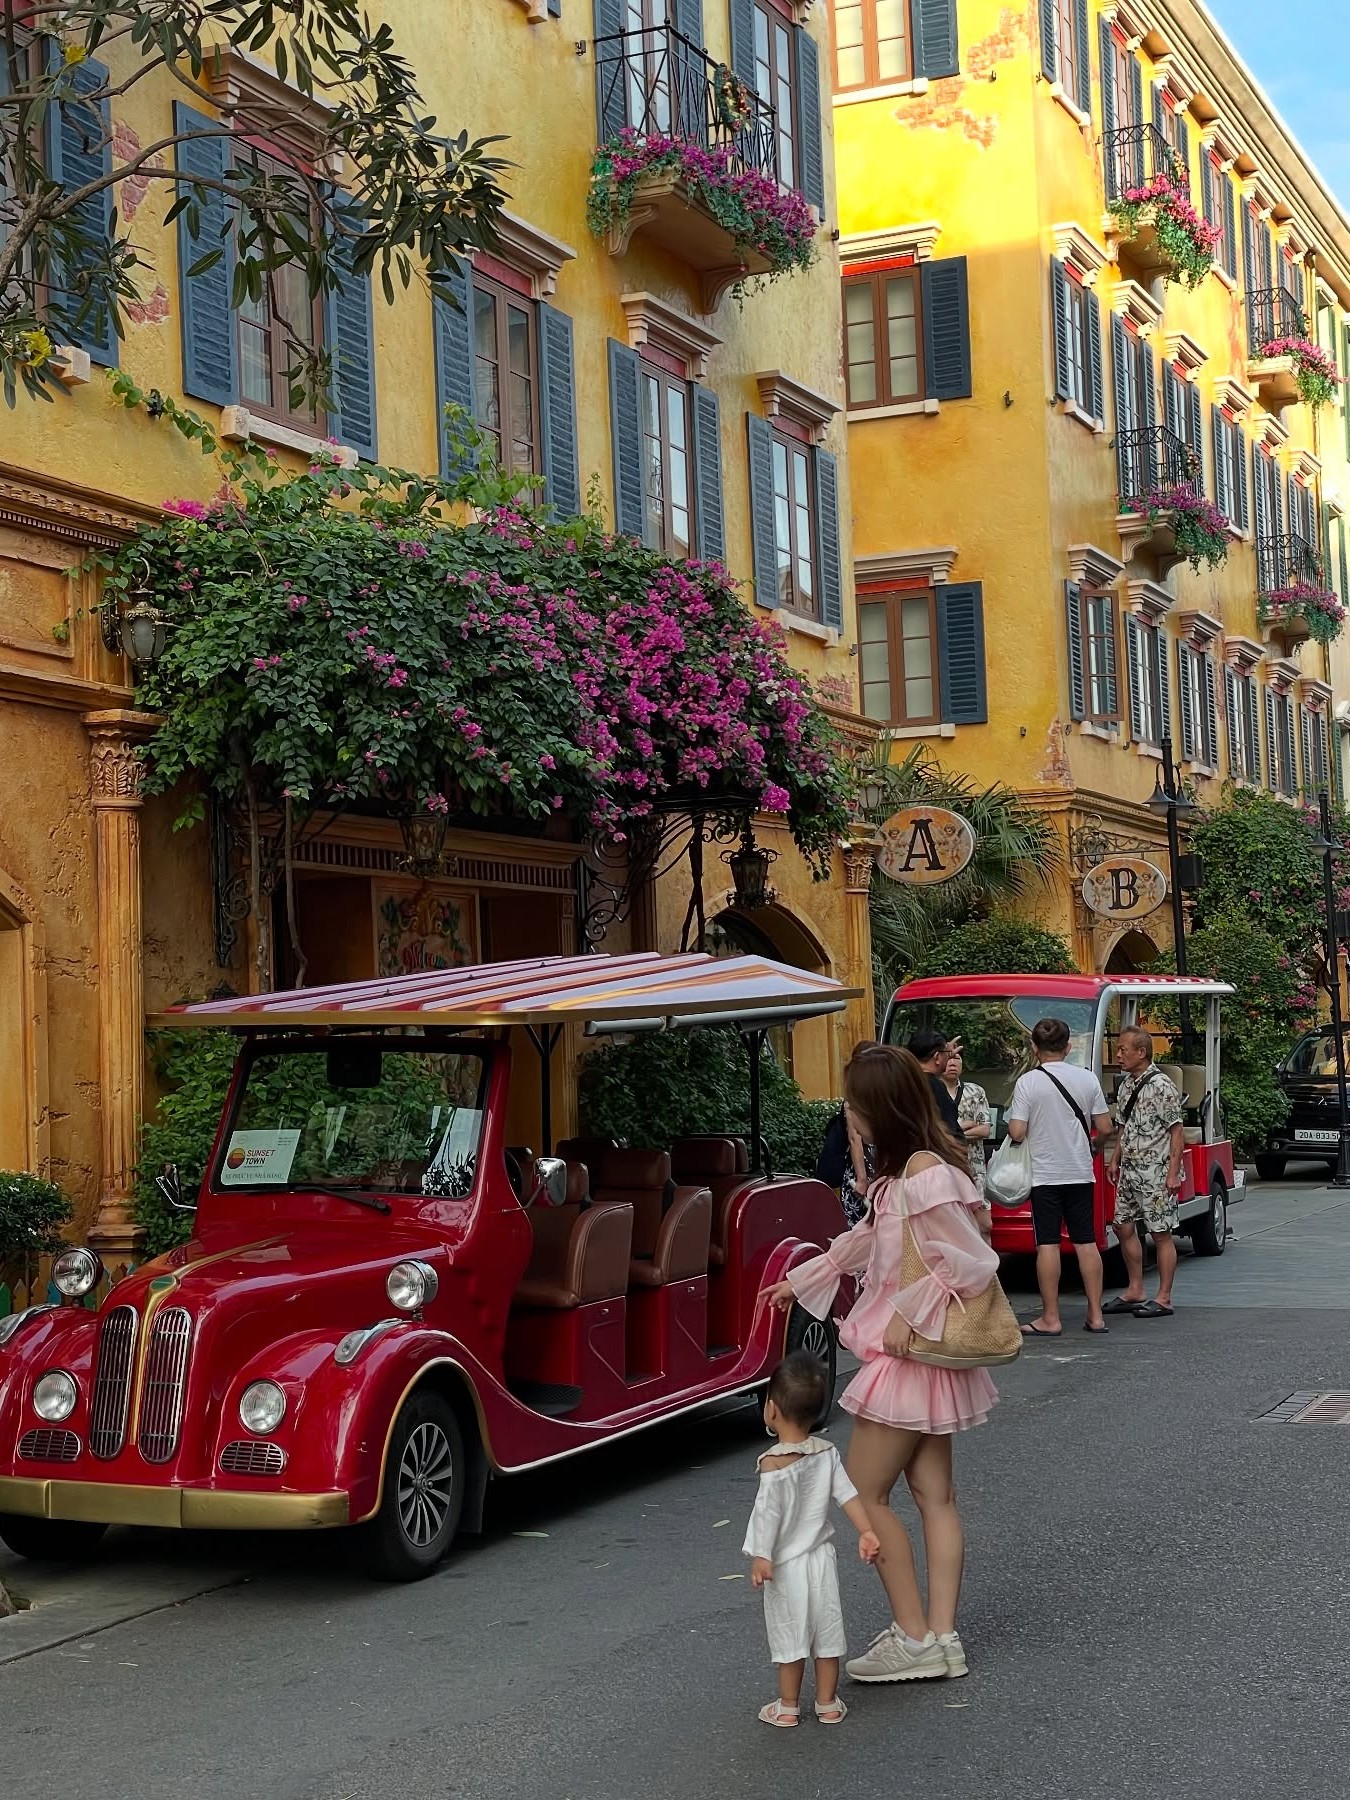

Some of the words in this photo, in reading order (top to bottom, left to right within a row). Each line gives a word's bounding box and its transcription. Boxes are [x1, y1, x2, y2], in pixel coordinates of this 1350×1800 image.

[898, 818, 946, 872] A
[1107, 867, 1139, 910] B
[245, 1157, 266, 1165] TOWN
[246, 1149, 276, 1157] SUNSET
